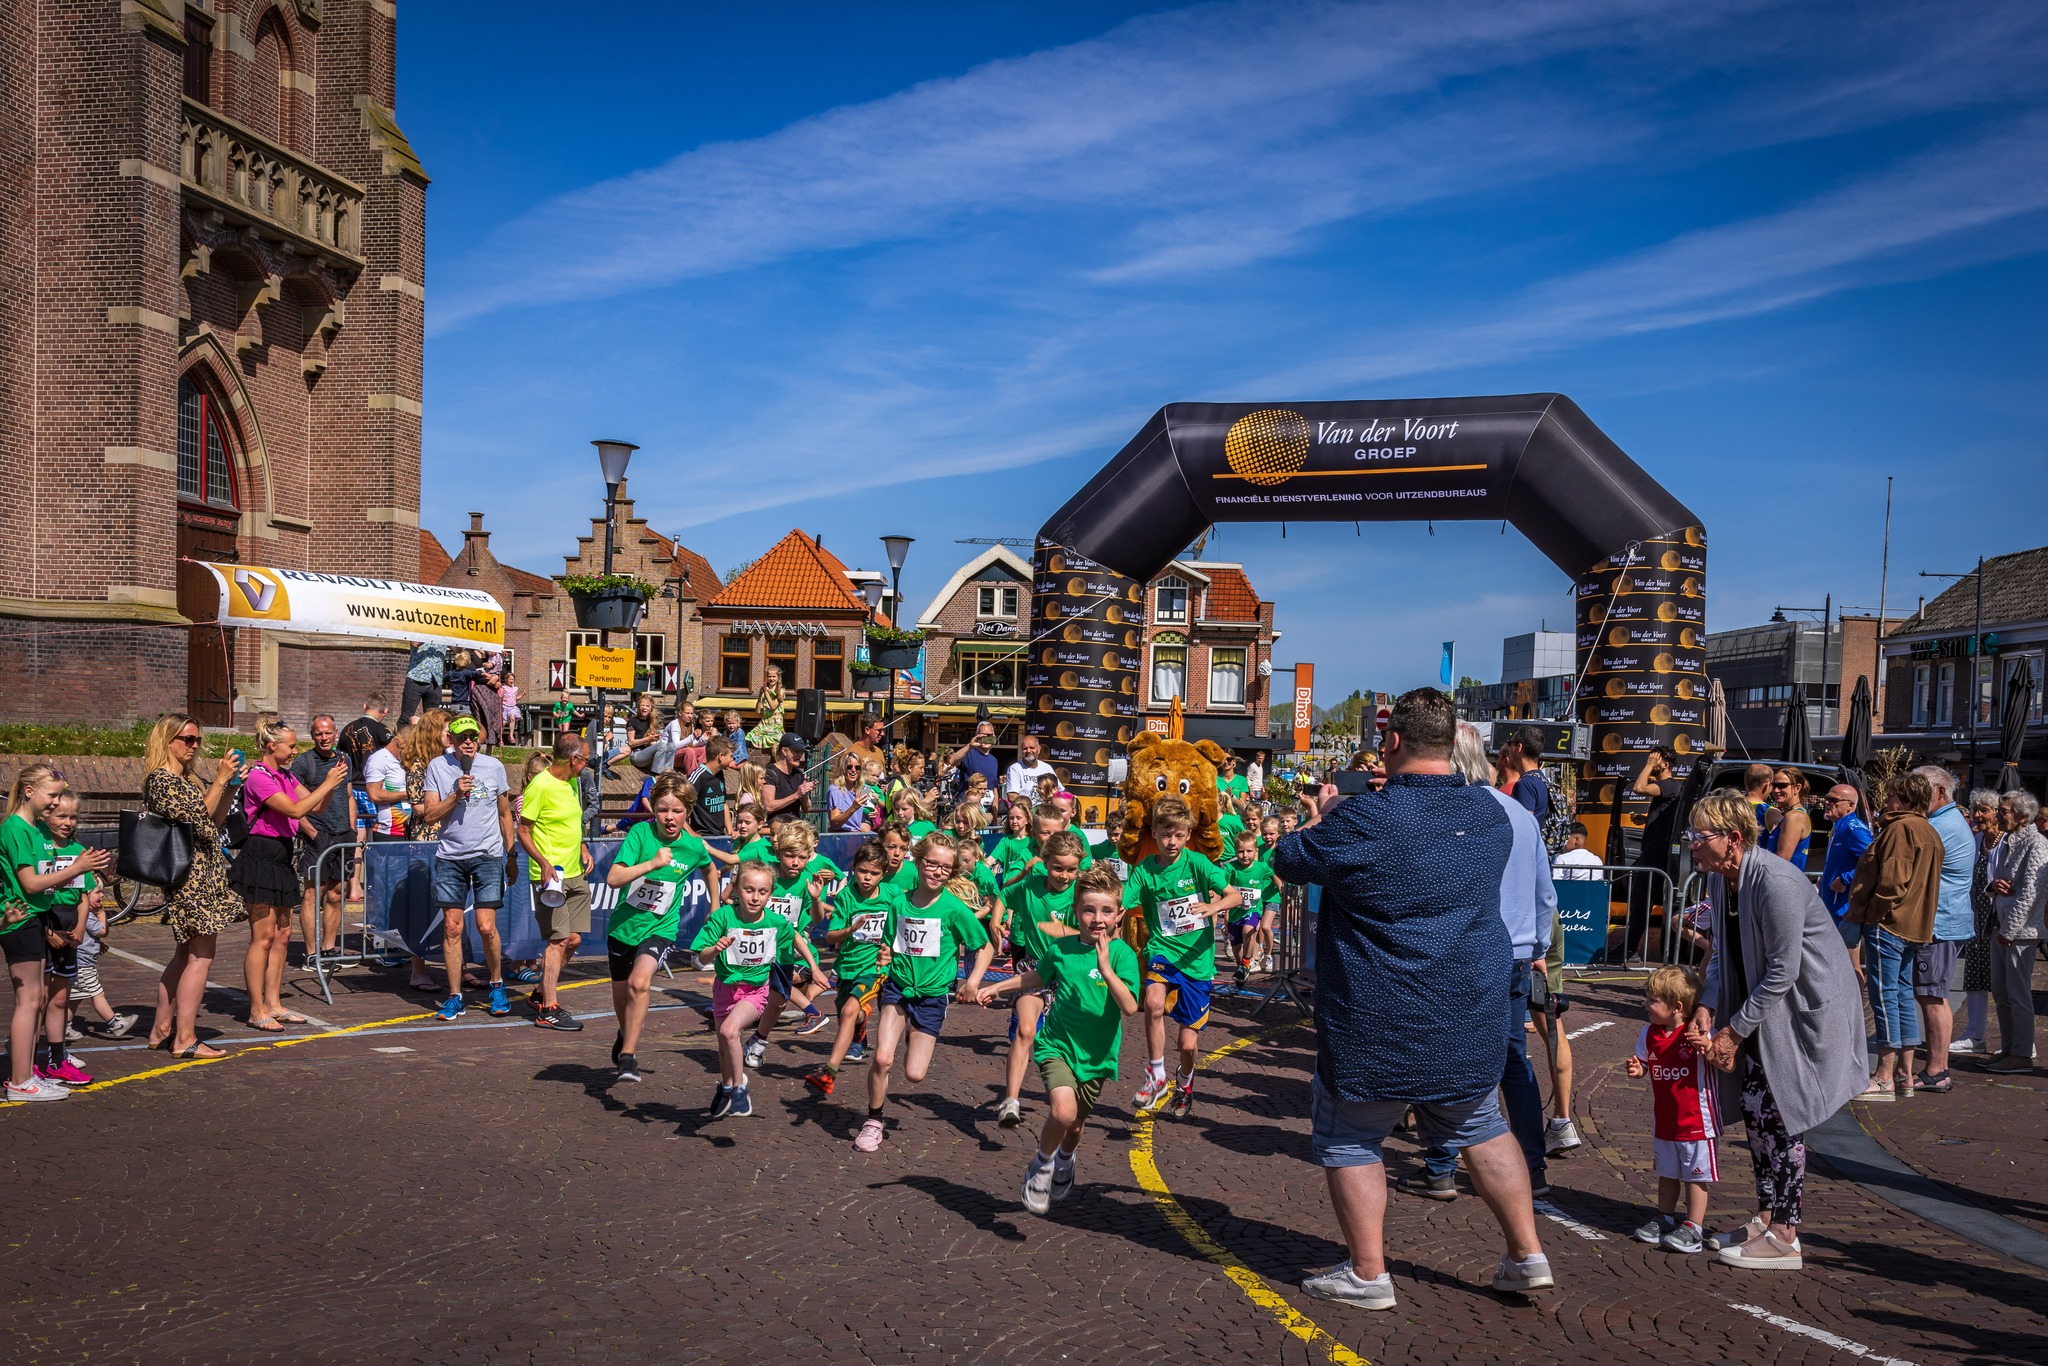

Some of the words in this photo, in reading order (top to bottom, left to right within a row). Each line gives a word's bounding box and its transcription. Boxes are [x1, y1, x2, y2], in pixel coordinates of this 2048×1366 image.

[1317, 421, 1353, 445] Van
[1360, 419, 1395, 443] der
[1403, 418, 1459, 441] Voort
[1354, 447, 1416, 460] GROEP
[1215, 494, 1271, 504] FINANCIËLE
[1273, 493, 1362, 503] DIENSTVERLENING
[1364, 492, 1394, 500] VOOR
[1395, 488, 1487, 499] UITZENDBUREAUS
[279, 570, 392, 590] RENAULT
[399, 582, 489, 603] Autozenter
[346, 603, 498, 635] www.autozenter.nl
[732, 620, 830, 637] HAVANA
[976, 622, 994, 634] Piet
[993, 622, 1018, 634] Pann
[589, 654, 624, 663] Verboden
[589, 674, 622, 683] Parkeren
[1295, 687, 1311, 729] Dino's
[1557, 730, 1571, 750] 2
[637, 887, 664, 903] 512
[1241, 892, 1254, 901] 89
[769, 903, 791, 915] 414
[1560, 909, 1591, 919] urs
[904, 929, 927, 943] 507
[739, 940, 765, 954] 501
